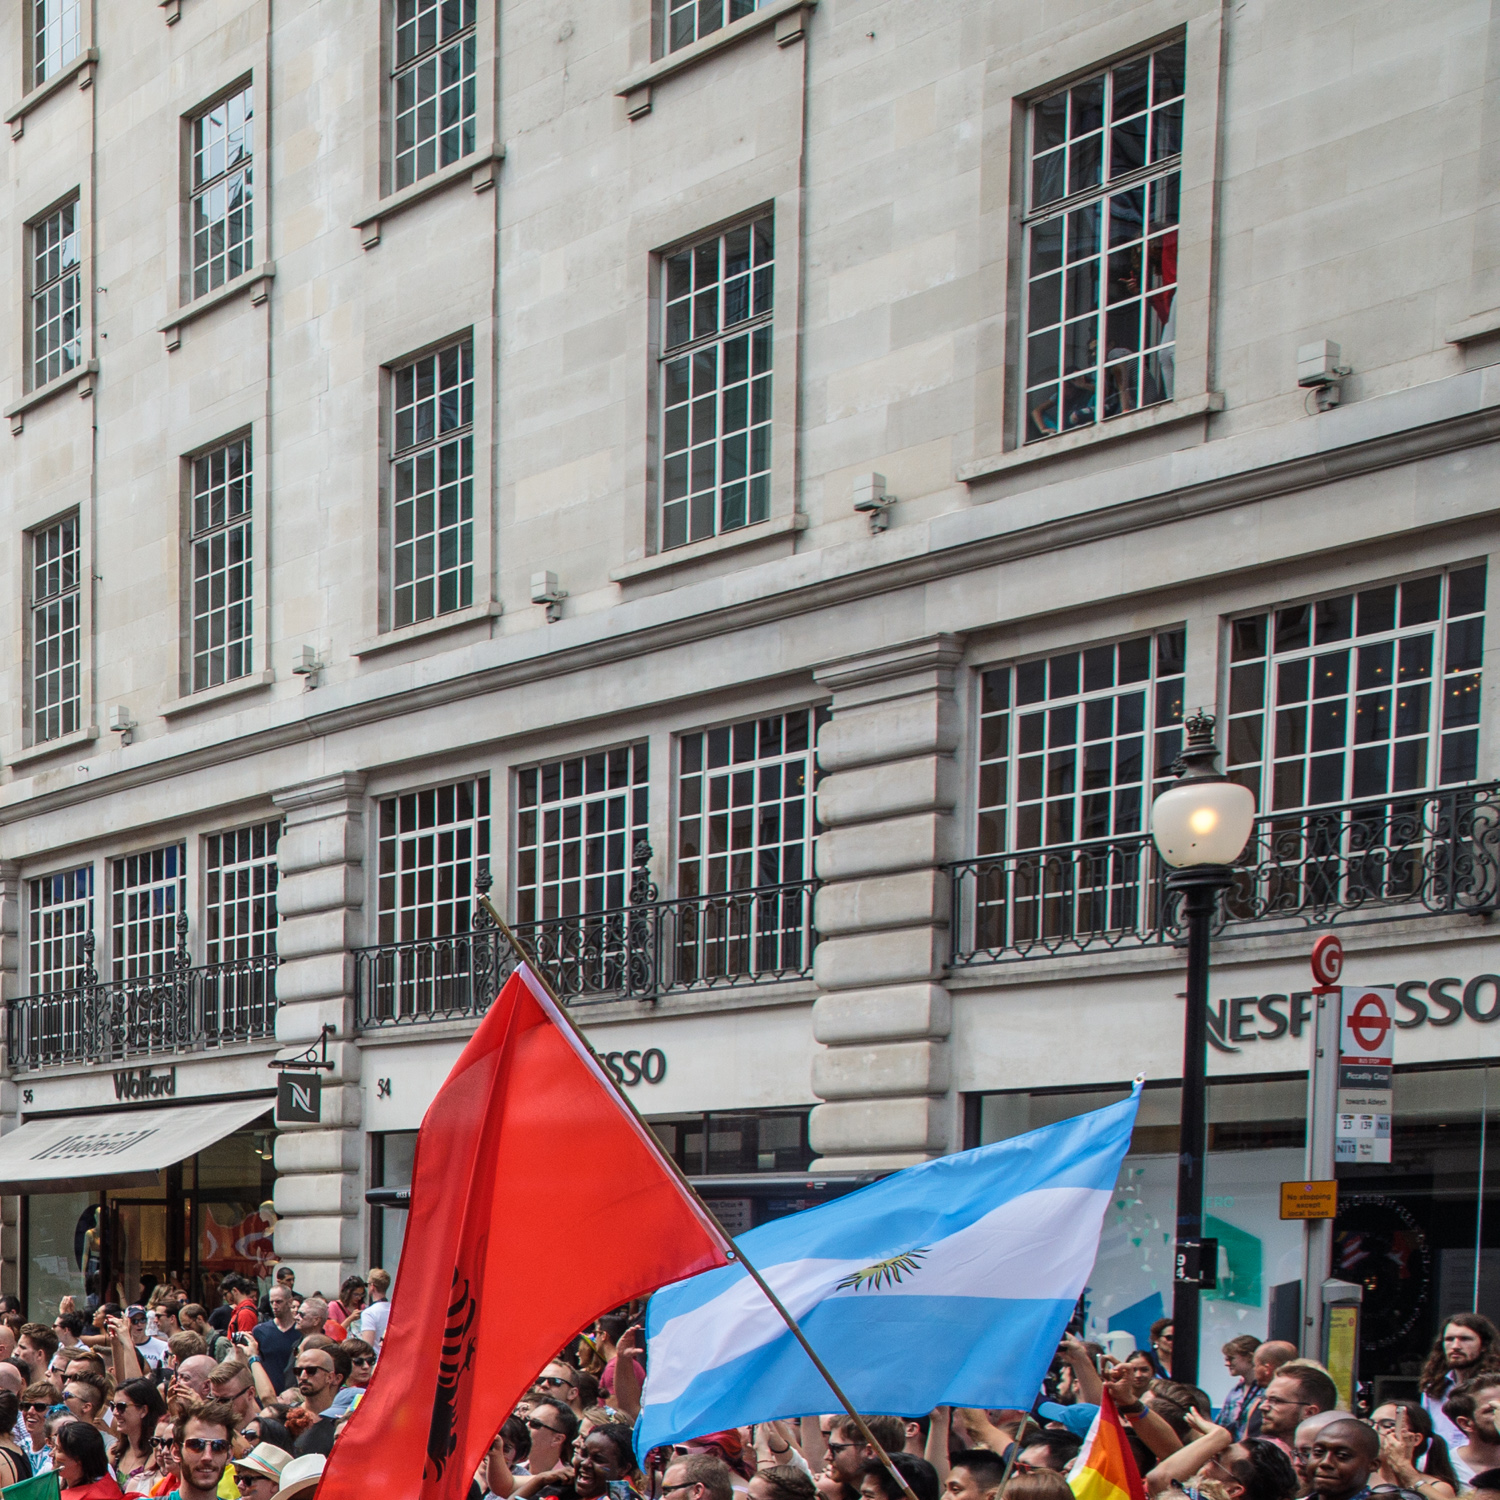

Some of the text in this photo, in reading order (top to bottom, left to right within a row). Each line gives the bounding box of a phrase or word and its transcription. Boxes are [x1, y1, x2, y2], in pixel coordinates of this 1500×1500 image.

[1321, 944, 1340, 979] G
[597, 1047, 667, 1086] SSO
[1346, 1071, 1389, 1080] Piccadilly Circus
[112, 1066, 177, 1101] Wolford
[377, 1078, 392, 1098] 54
[22, 1089, 34, 1104] 56
[1343, 1120, 1352, 1129] 23
[1360, 1121, 1372, 1130] 139
[1337, 1144, 1356, 1153] N113
[1299, 1193, 1332, 1201] stopping
